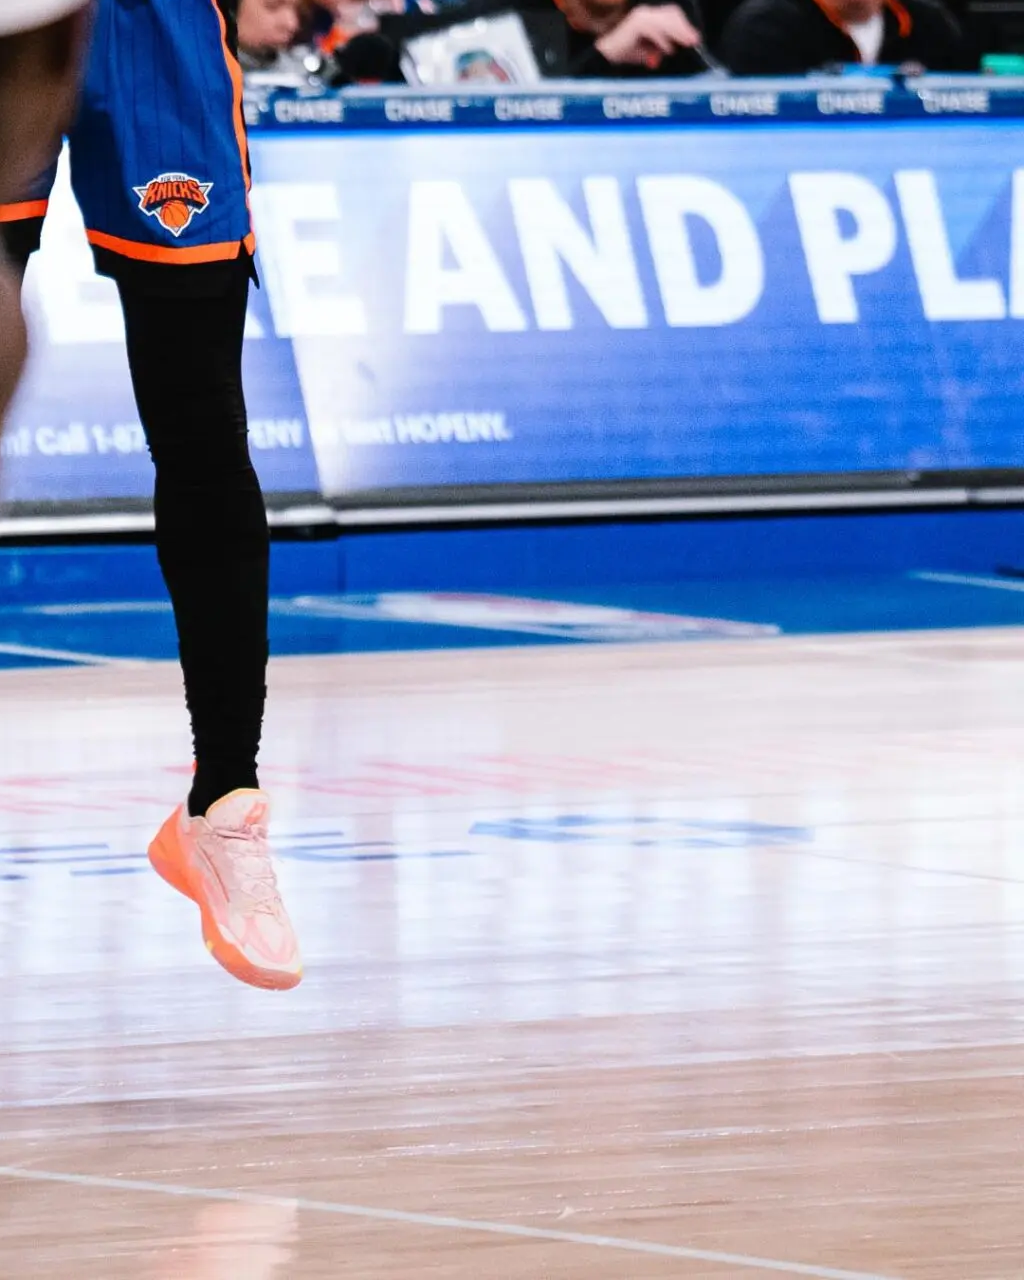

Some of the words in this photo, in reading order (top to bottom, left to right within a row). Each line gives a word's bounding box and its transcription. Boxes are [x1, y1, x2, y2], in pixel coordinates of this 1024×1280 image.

[141, 179, 207, 209] KNICKS
[403, 171, 765, 335] AND
[787, 168, 1024, 326] PL
